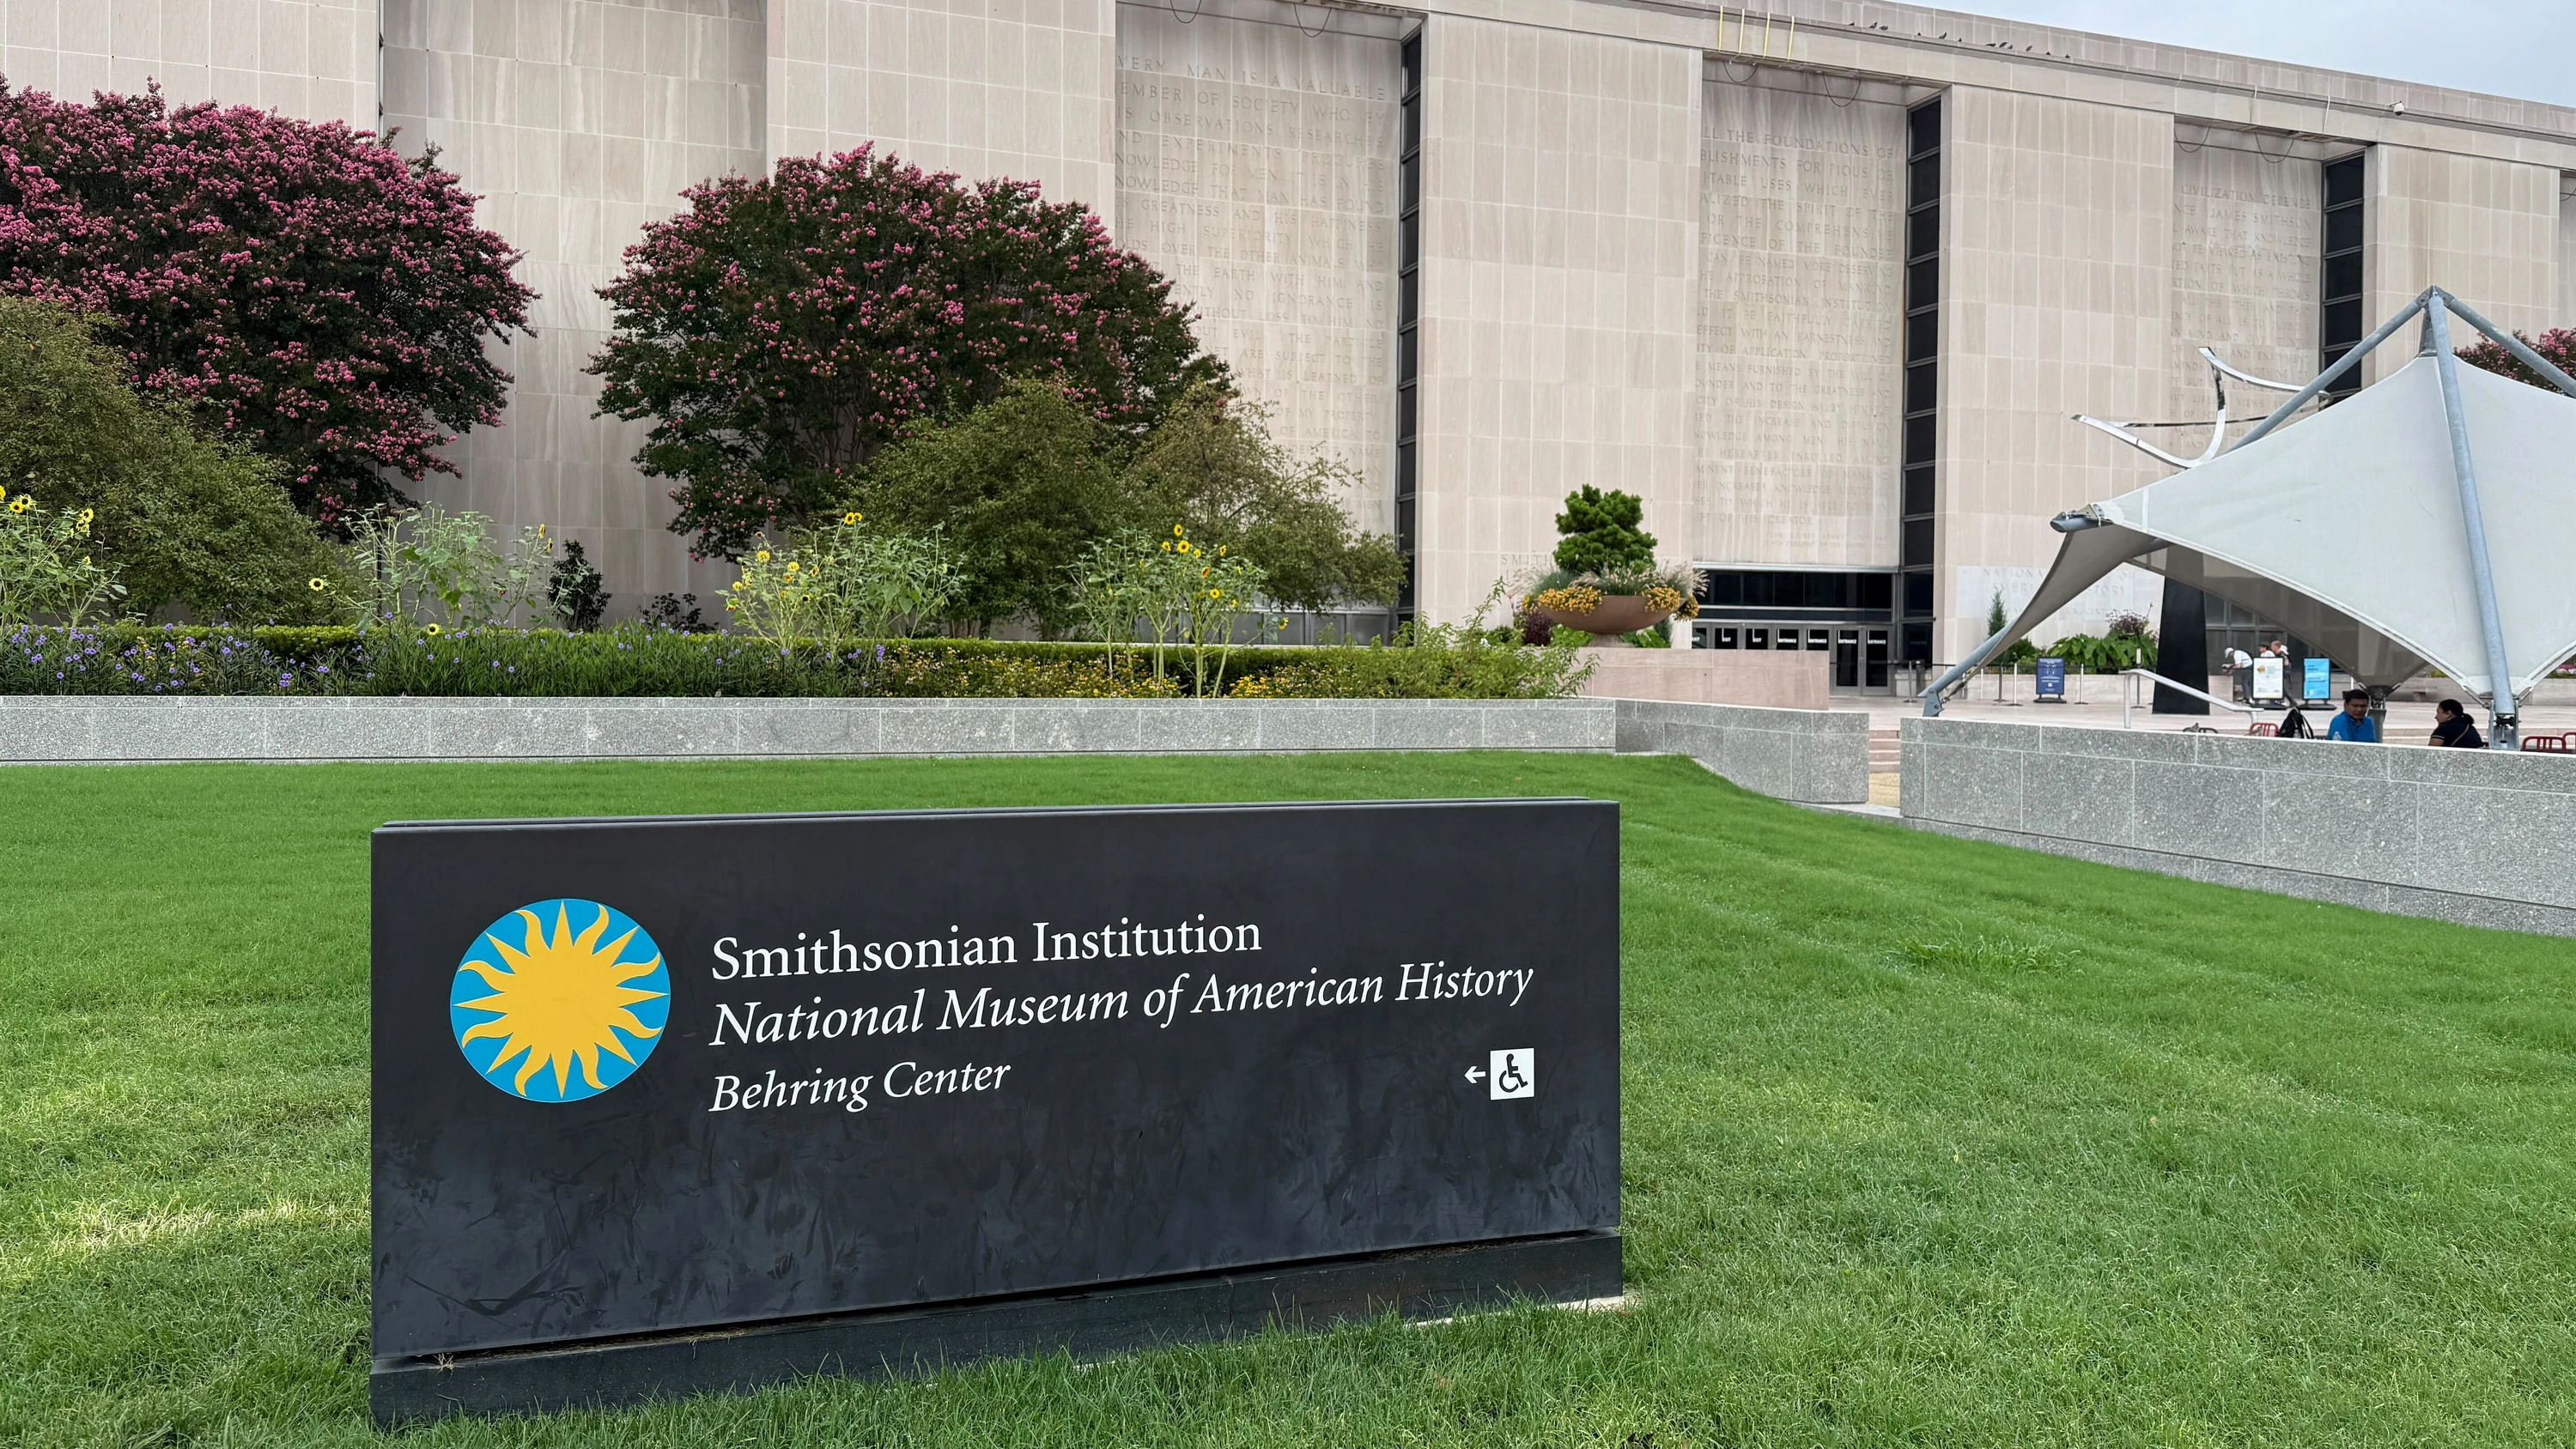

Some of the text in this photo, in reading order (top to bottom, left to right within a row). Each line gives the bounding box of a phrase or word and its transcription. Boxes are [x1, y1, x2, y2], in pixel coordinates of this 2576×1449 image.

[1188, 64, 1226, 81] MAN
[1242, 71, 1257, 83] IS
[1271, 76, 1280, 87] A
[1295, 78, 1385, 100] VALUABLE
[1115, 82, 1385, 125] EMBER OF SOCIETY WHO BY
[1150, 111, 1273, 135] OBSERVATIONS
[1289, 126, 1383, 149] RESEARCHES
[1162, 135, 1282, 159] EXPERIMENTS
[1727, 129, 1893, 159] THE FOUNDATIONS OF
[1212, 163, 1236, 176] FOR
[1797, 160, 1820, 173] FOR
[1830, 163, 1868, 179] PIOUS
[1761, 178, 1791, 191] USES
[1804, 182, 1848, 197] WHICH
[2182, 184, 2254, 202] CIVILIZATION
[1142, 200, 1219, 217] GREATNESS
[1234, 209, 1261, 221] AND
[1300, 194, 1327, 208] HAS
[1337, 198, 1383, 213] FOUND
[1759, 197, 1784, 210] THE
[1796, 203, 1836, 216] SPIRIT
[1846, 207, 1861, 218] OF
[1736, 215, 1761, 228] THE
[2210, 208, 2246, 221] JAMES
[1151, 221, 1185, 234] HIGH
[1204, 226, 1291, 244] SUPERIORITY
[2184, 225, 2217, 237] AWARE
[1162, 242, 1194, 256] OVER
[1208, 246, 1230, 258] THE
[1240, 250, 1279, 264] OTHER
[1290, 254, 1344, 268] ANIMALS
[1769, 239, 1785, 251] OF
[1797, 241, 1820, 253] THE
[2208, 246, 2245, 258] VIEWED
[2251, 249, 2262, 260] AS
[1176, 264, 1383, 291] THE EARTH WITH AND
[1235, 289, 1352, 308] NO IGNORANCE
[1704, 288, 1723, 300] THE
[1734, 290, 1809, 306] SMITHSONIAN
[1302, 314, 1316, 324] TO
[1722, 308, 1733, 319] IT
[1768, 312, 1832, 325] FAITHFULLY
[1288, 333, 1310, 343] THE
[1697, 324, 1733, 337] EFFECT
[1741, 328, 1766, 339] WITH
[1240, 349, 1351, 365] ARE SUBJECT TO
[1742, 346, 1806, 359] APPLICATION
[1283, 371, 1356, 384] IS LEARNED
[1708, 361, 1844, 379] MEANS FURNISHED THE
[1303, 391, 1324, 400] THE
[1338, 392, 1377, 403] OTHER
[1743, 382, 1763, 391] AND
[1770, 383, 1783, 392] TO
[1790, 384, 1807, 394] THE
[1747, 398, 1803, 409] HIS DESIGN
[1727, 415, 1831, 428] THE INCREASE AND
[1757, 433, 1822, 445] AMONG MEN
[1502, 554, 1552, 566] SMITH
[711, 914, 1262, 980] Smithsonian Institution
[708, 961, 1534, 1046] National Museum of American History
[708, 1061, 1012, 1113] Behring Center
